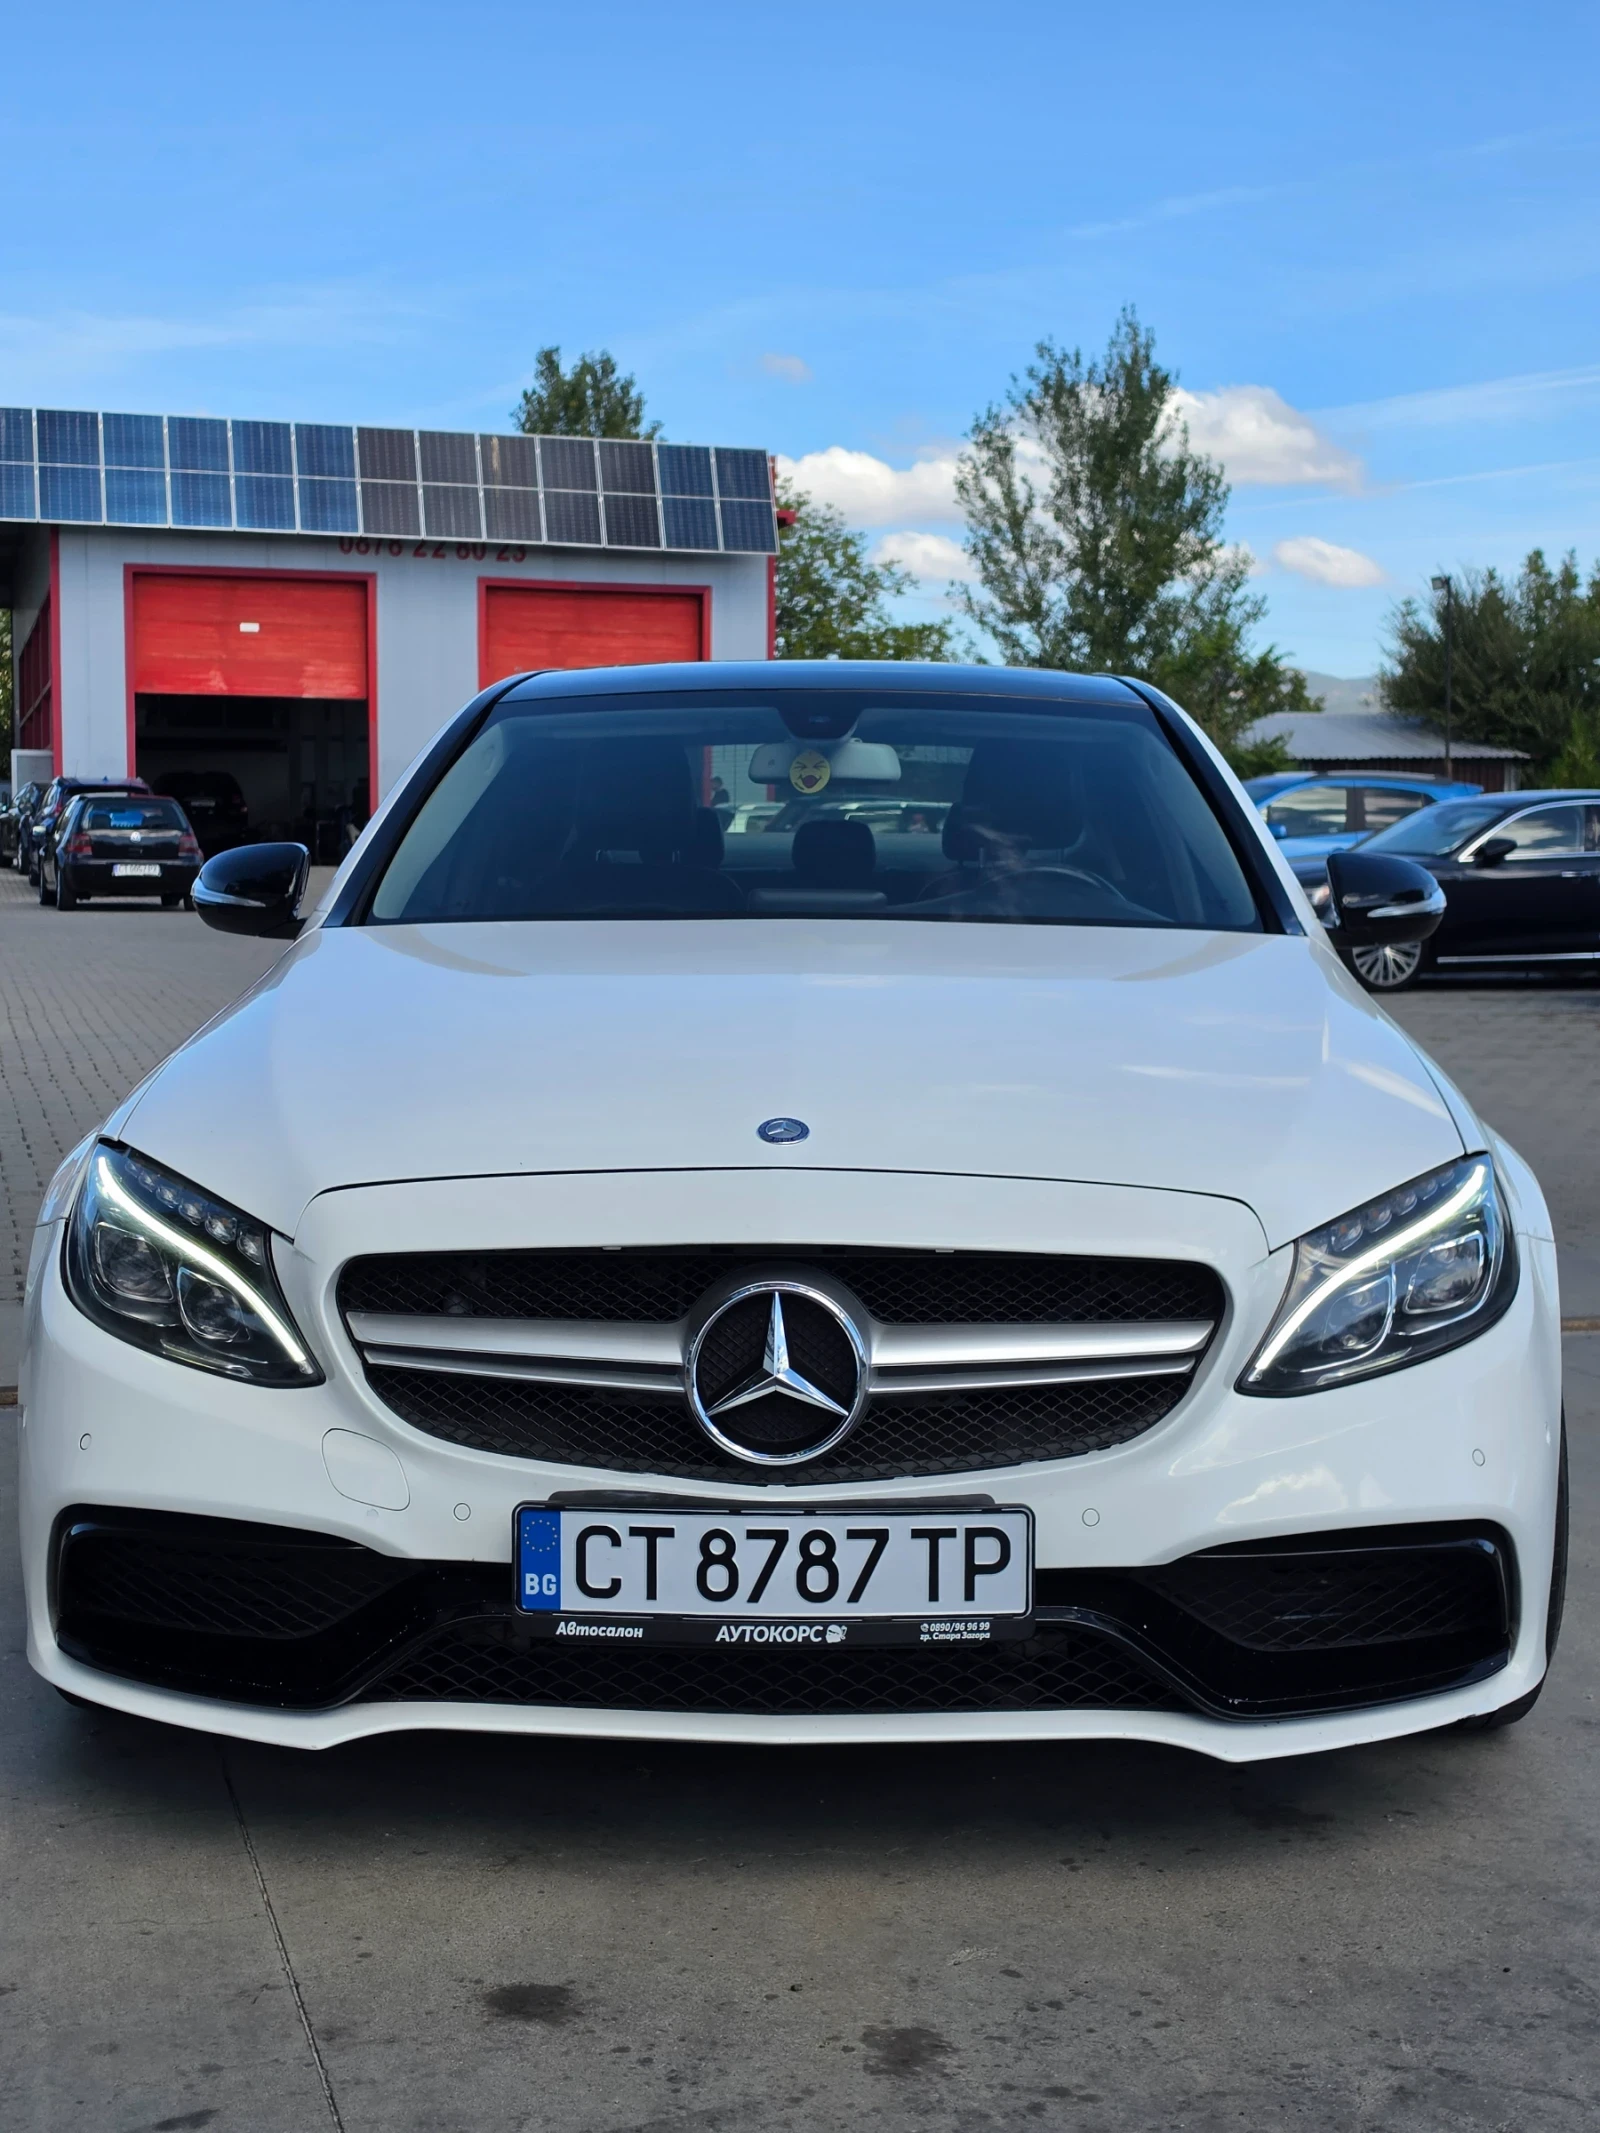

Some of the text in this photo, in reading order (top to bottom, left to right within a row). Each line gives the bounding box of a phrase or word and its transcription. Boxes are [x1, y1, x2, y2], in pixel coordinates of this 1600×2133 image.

[695, 1528, 890, 1604] 8787
[525, 1573, 558, 1596] BG
[555, 1621, 644, 1638] Автосалон
[715, 1625, 824, 1643] АУТОКОРС
[930, 1621, 991, 1632] 0890/96 96 99
